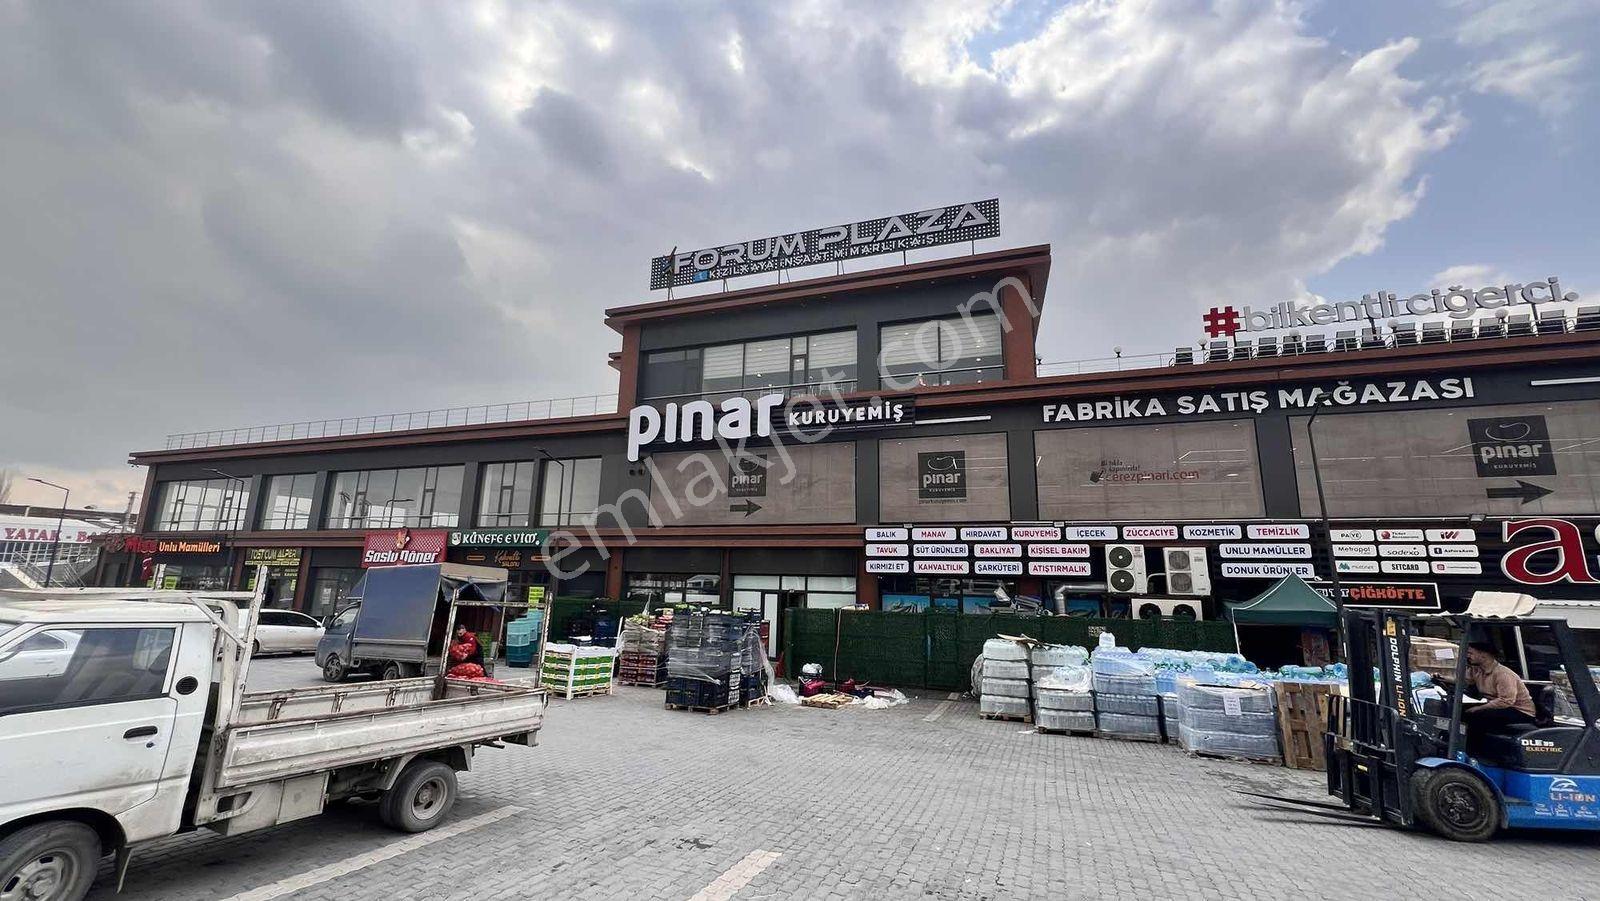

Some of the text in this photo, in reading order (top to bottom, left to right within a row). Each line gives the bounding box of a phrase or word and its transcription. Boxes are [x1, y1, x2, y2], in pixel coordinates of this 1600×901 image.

[674, 202, 990, 275] FORUM PLAZA
[1203, 290, 1397, 338] #bilkentli
[1043, 377, 1475, 423] FABRİKA SATIŞ MAĞAZASI
[788, 401, 904, 426] KURUYEMİŞ
[4, 527, 62, 541] YATAK
[876, 530, 897, 538] BALIK
[921, 530, 947, 538] MANAV
[965, 530, 1001, 538] HIRDAVAT
[1014, 528, 1059, 539] KURUYEMİŞ
[1076, 528, 1106, 539] İÇECEK
[1126, 527, 1175, 537] ZÜCCACİYE
[1189, 526, 1236, 537] KOZMETİK
[1256, 526, 1300, 536] TEMİZLİK
[159, 541, 178, 552] Unlu
[178, 541, 221, 553] Mamülleri
[876, 546, 898, 554] TAVUK
[916, 544, 967, 554] SÜT ÜRÜNLERİ
[979, 545, 1015, 555] BAKLİYAT
[1030, 545, 1087, 555] KİŞİSEL BAKIM
[1225, 544, 1306, 555] UNLU MAMÜLLER
[365, 550, 399, 563] Soslu
[918, 563, 964, 571] KAHVALTILIK
[977, 562, 1020, 573] ŞARKÜTERİ
[1032, 563, 1088, 574] ATIŞTIRMALIK
[1226, 565, 1261, 575] DONUK
[1391, 563, 1419, 571] SETCARD
[1350, 585, 1426, 600] ÇİĞKÖFTE
[1389, 637, 1402, 682] DOLPHIN
